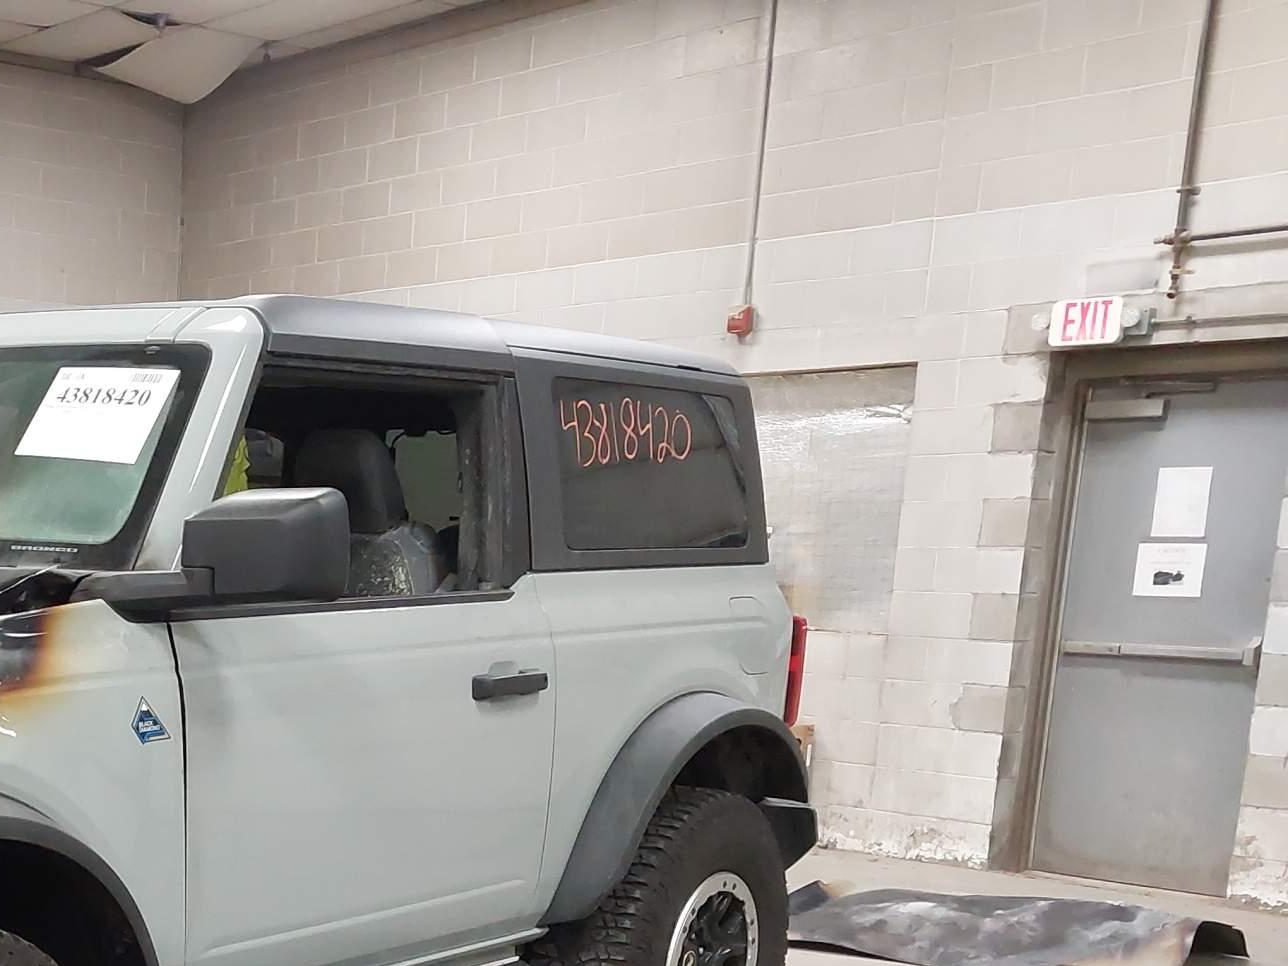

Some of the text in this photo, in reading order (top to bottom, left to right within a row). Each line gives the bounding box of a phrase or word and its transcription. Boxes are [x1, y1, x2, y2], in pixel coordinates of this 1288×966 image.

[1061, 300, 1113, 341] EXIT
[57, 387, 151, 406] 43818420
[560, 397, 692, 467] 43818420
[10, 544, 79, 553] BRONCO
